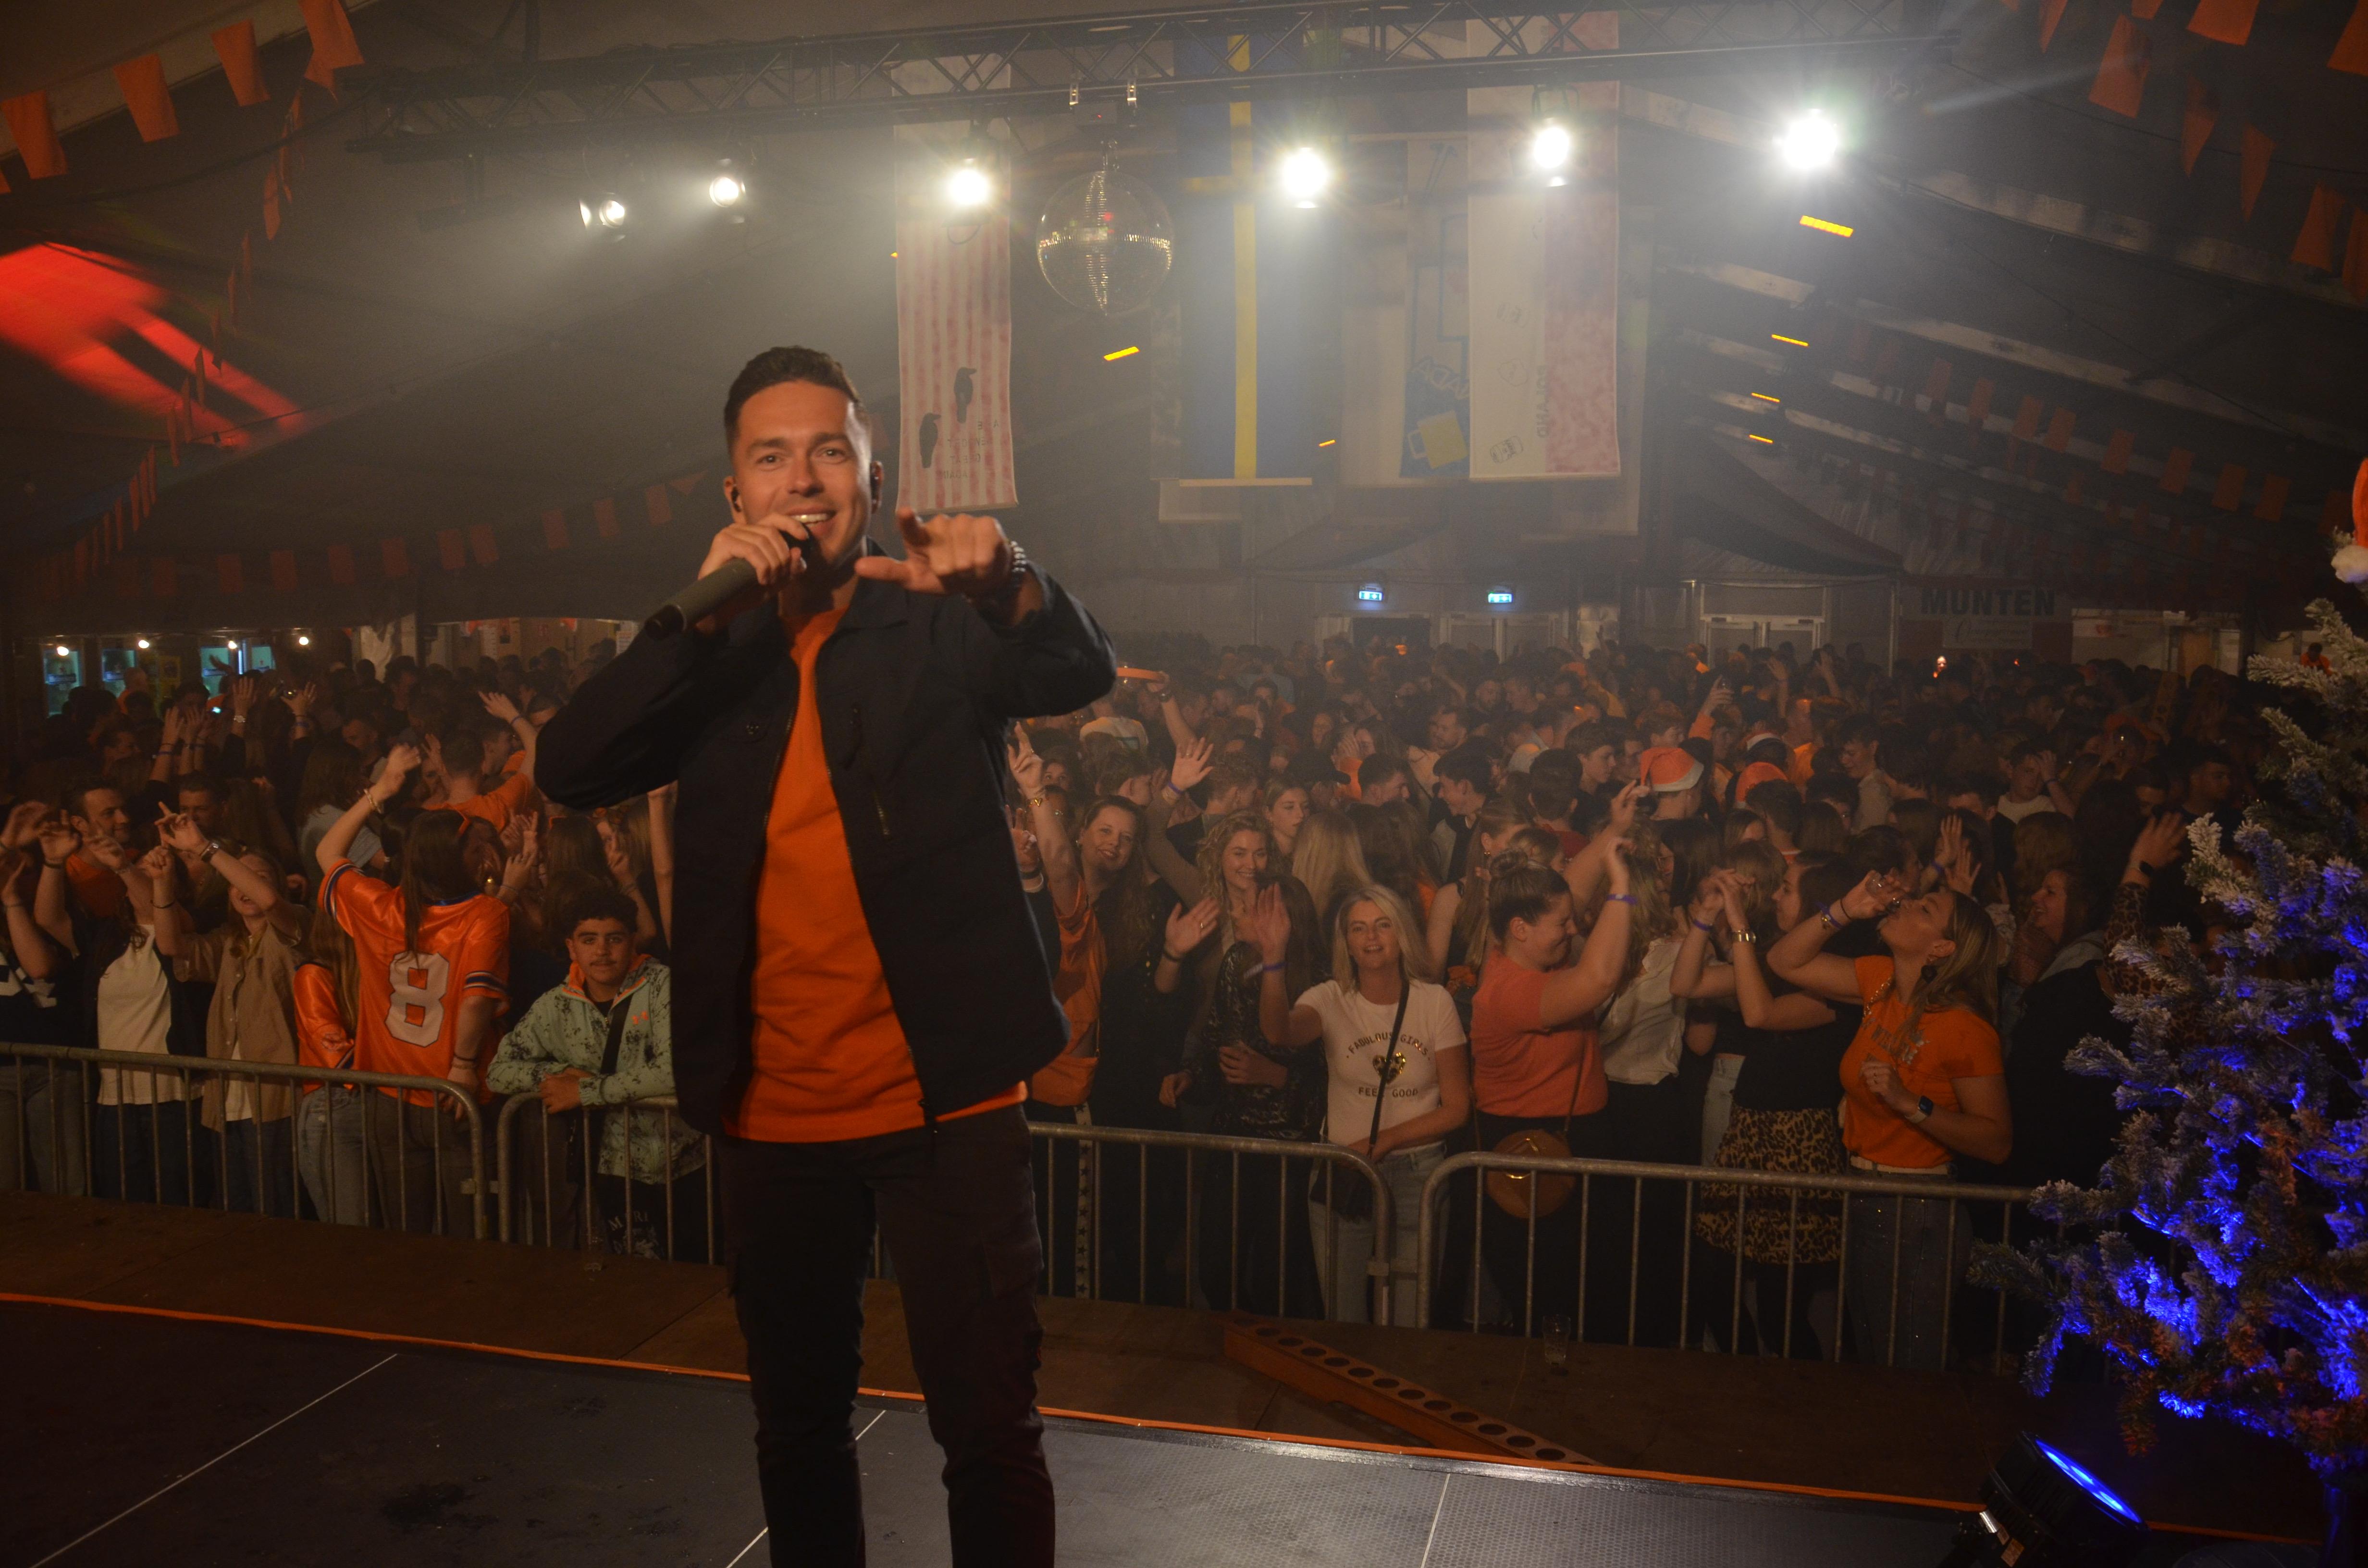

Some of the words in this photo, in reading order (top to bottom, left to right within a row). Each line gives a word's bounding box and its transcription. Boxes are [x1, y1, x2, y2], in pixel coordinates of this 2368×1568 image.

[1921, 588, 2055, 615] MUNTEN
[385, 950, 450, 1047] 8
[1400, 1034, 1429, 1055] GIRLS
[1359, 1087, 1384, 1097] FEE
[1392, 1088, 1418, 1098] GOOD
[607, 1210, 649, 1231] MRI
